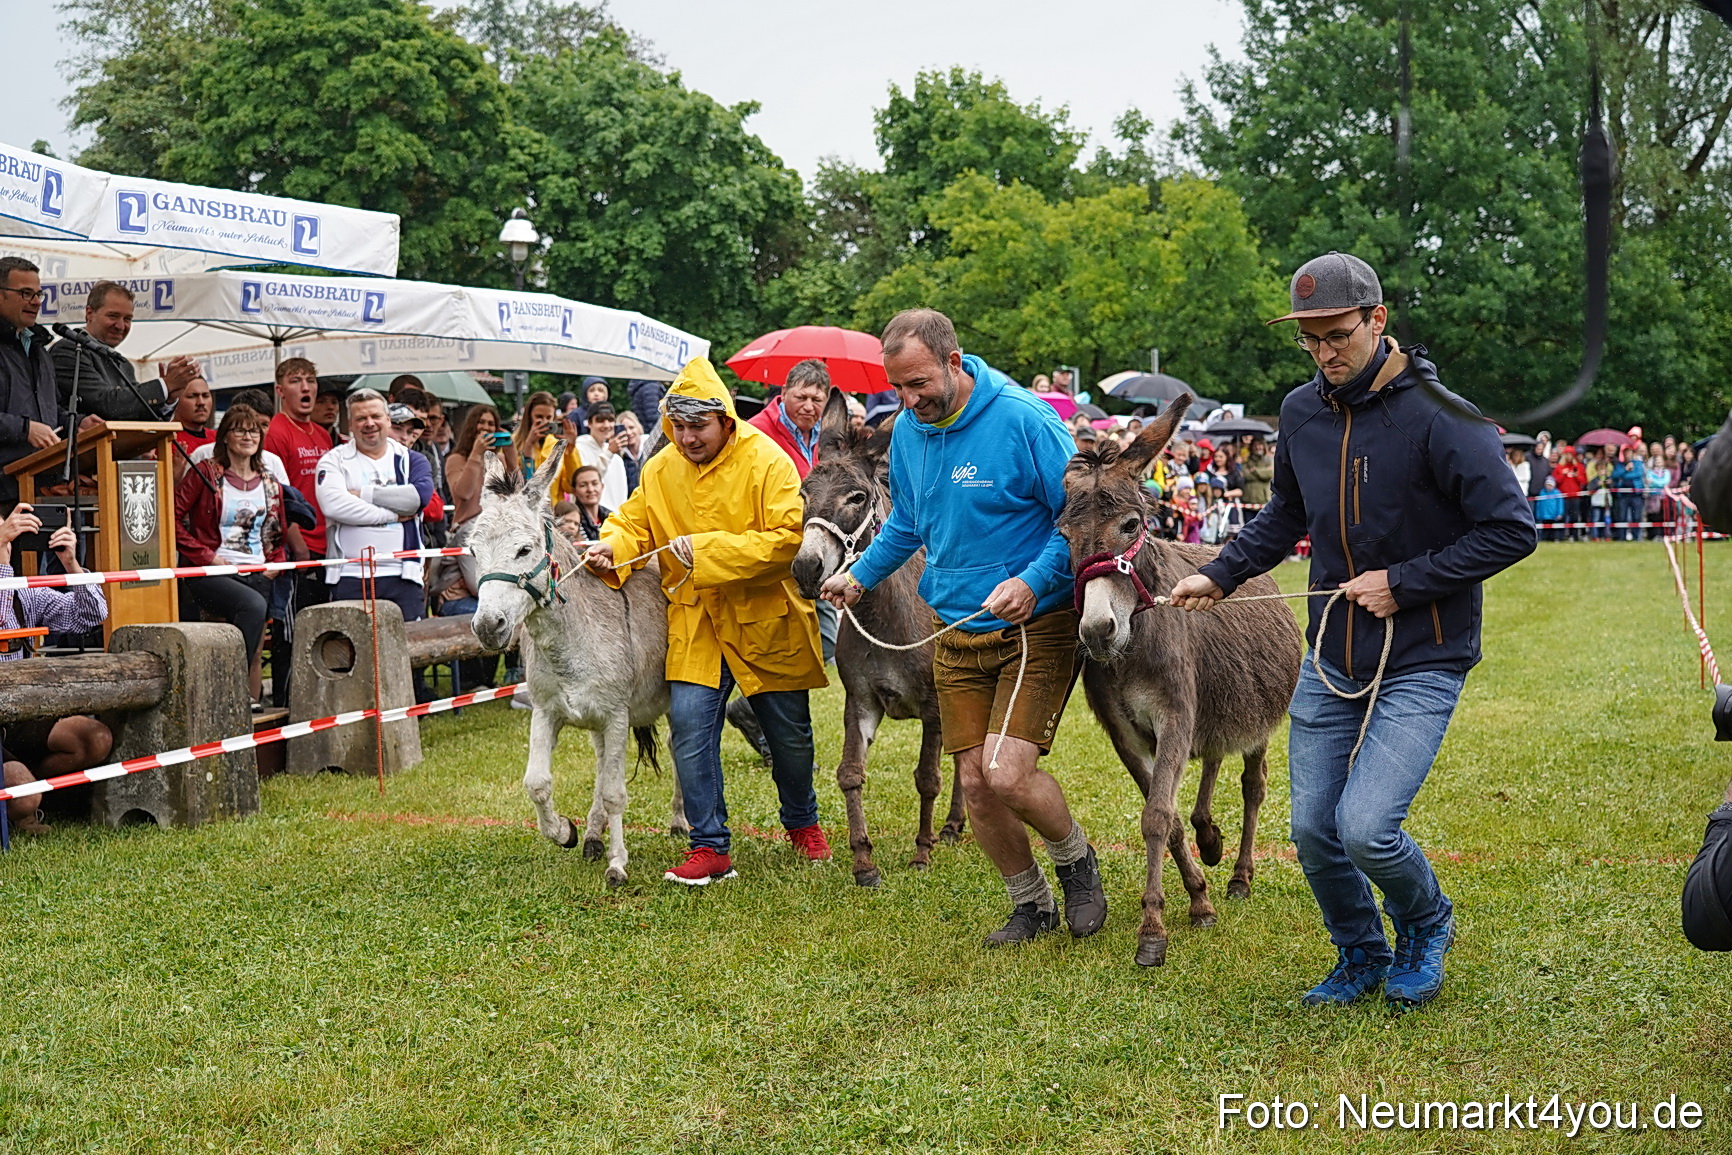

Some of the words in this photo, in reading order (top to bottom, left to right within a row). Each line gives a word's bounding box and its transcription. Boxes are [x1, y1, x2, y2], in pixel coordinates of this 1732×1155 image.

[152, 192, 288, 227] GANSBRÄU
[152, 219, 215, 236] Neumarkt's
[217, 230, 243, 241] guter
[265, 281, 362, 303] GANSBRÄU
[132, 550, 150, 567] Stadt
